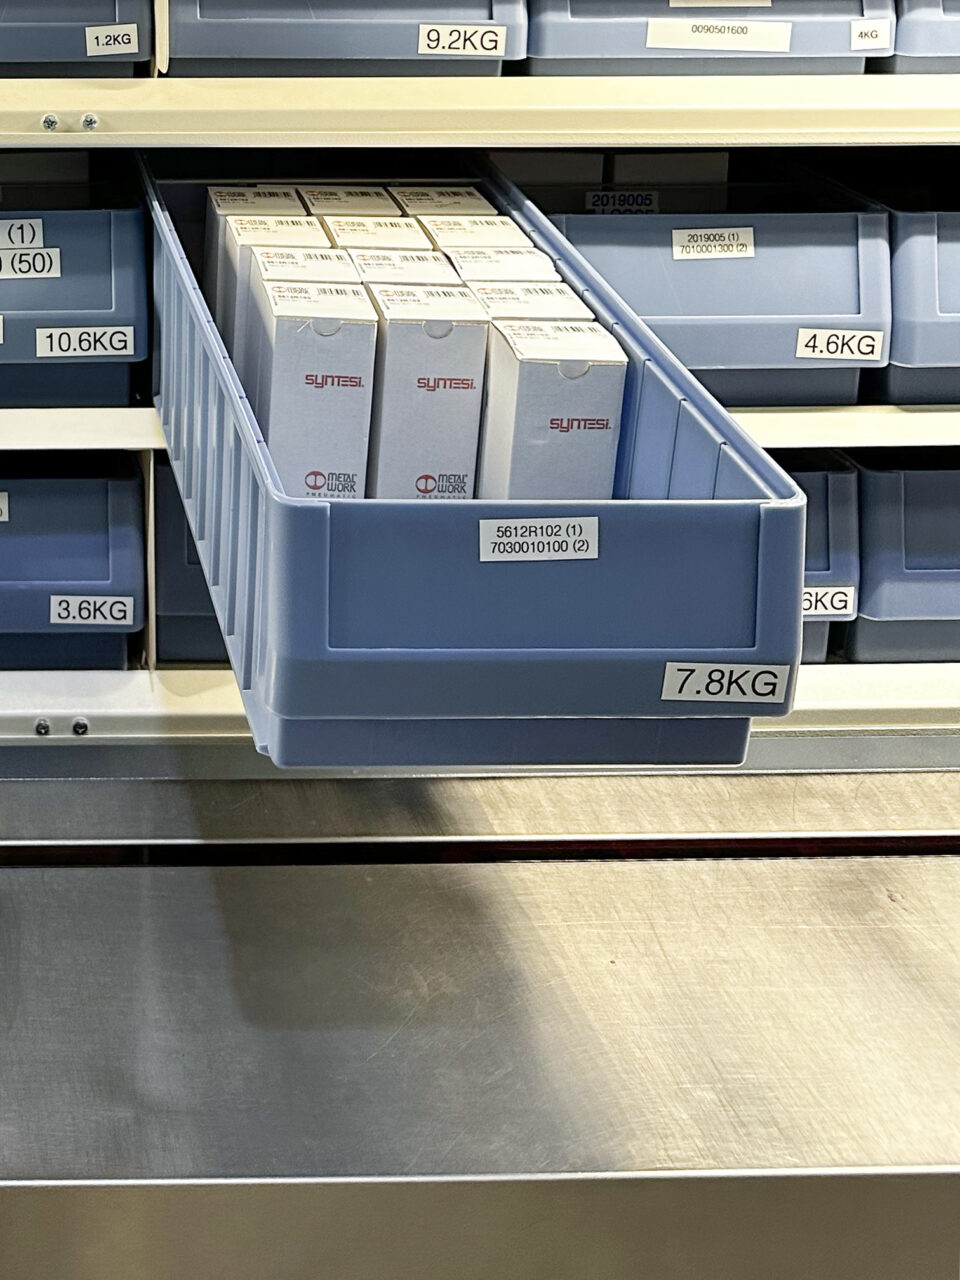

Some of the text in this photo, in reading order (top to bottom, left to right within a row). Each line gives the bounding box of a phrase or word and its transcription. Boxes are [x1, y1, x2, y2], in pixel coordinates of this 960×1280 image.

[691, 24, 749, 35] 0090501600
[857, 29, 879, 39] 4KG
[94, 33, 132, 47] 1.2KG
[426, 28, 499, 51] 9.2KG
[591, 193, 654, 208] 2019005
[7, 224, 36, 244] (1)
[687, 231, 740, 244] 2019005 (1)
[680, 243, 747, 254] 7010001300 (2)
[10, 251, 54, 275] (50)
[45, 330, 128, 353] 10.6KG
[804, 333, 876, 356] 4.6KG
[328, 472, 357, 483] METAL
[438, 474, 467, 484] METAL
[328, 482, 356, 492] WORK
[438, 483, 466, 493] WORK
[496, 523, 583, 539] 5612R102 (1)
[490, 538, 590, 554] 7030010100 (2)
[57, 599, 127, 621] 3.6KG
[676, 668, 779, 697] 7.8KG
